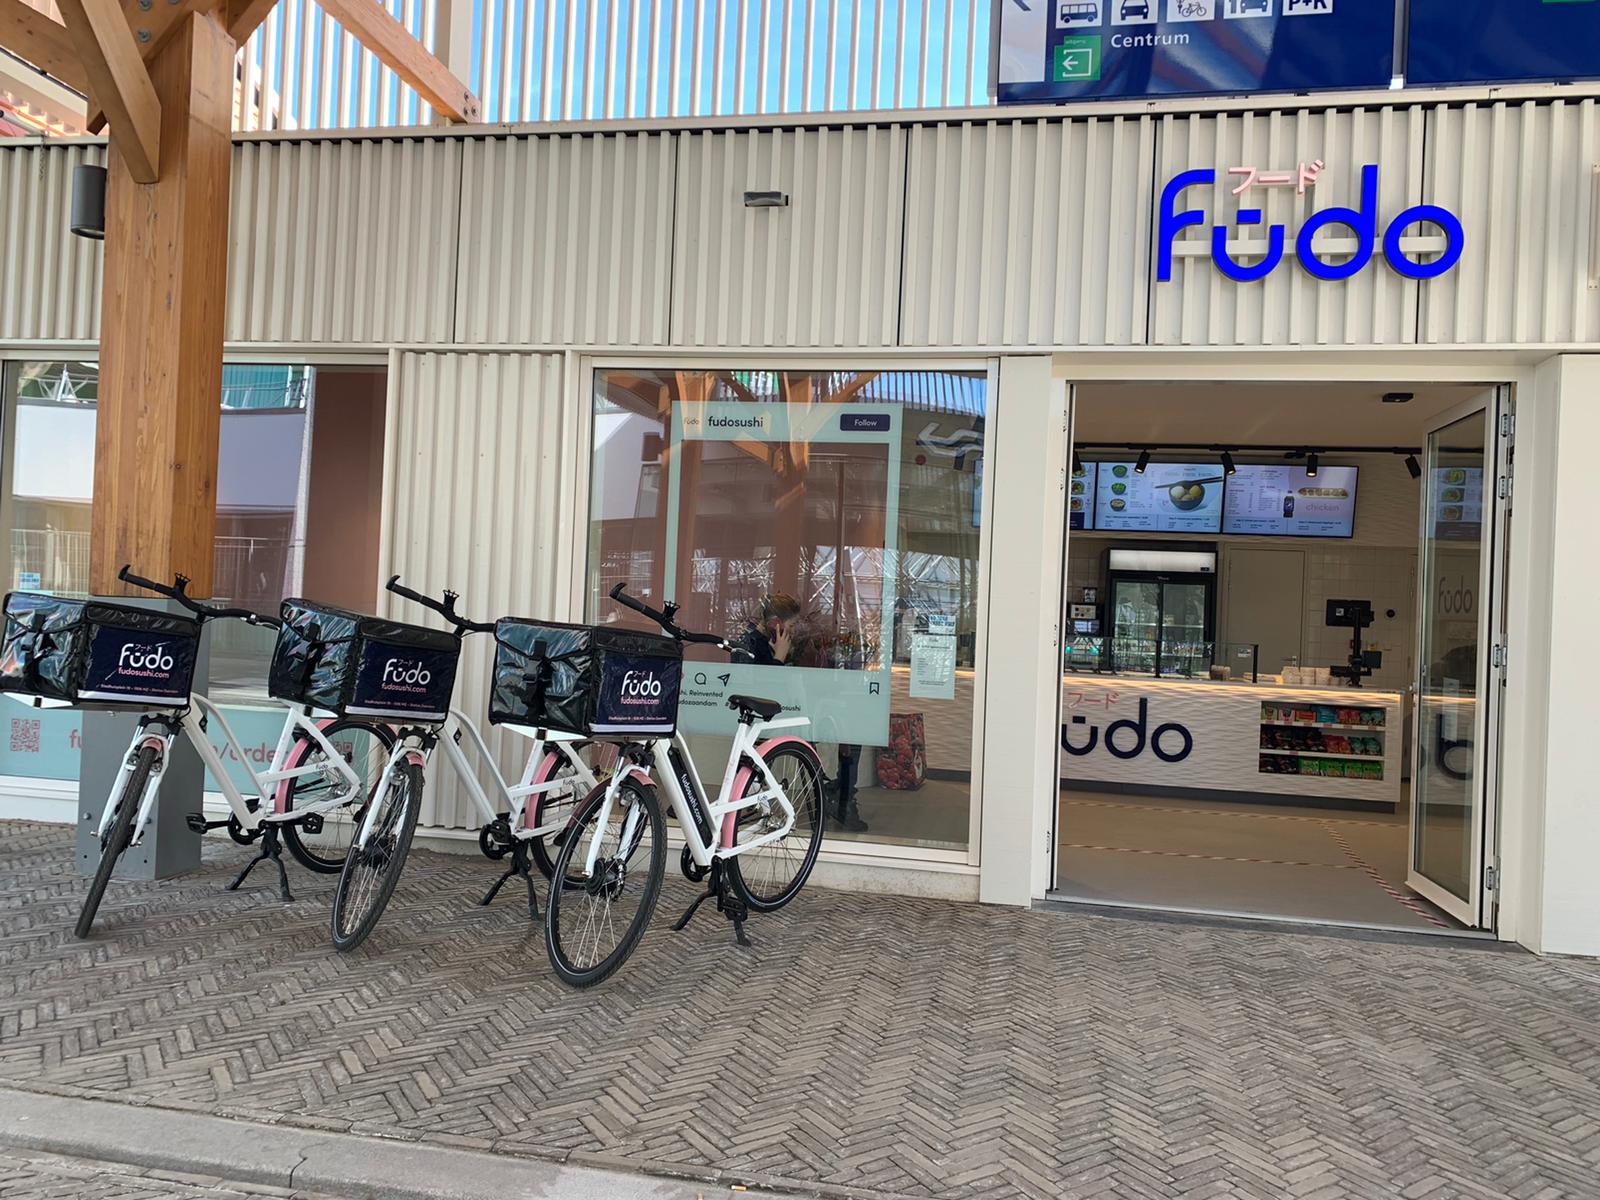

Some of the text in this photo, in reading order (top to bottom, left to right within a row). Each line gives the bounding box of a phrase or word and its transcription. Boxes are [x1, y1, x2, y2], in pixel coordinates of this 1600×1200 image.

[1111, 33, 1190, 48] Centrum
[1228, 159, 1325, 195] フード
[708, 415, 763, 428] fudosushi
[854, 419, 878, 427] Follow
[1305, 503, 1340, 512] chicken
[118, 667, 170, 679] fudosushi.com
[381, 682, 427, 693] fudosushi.com
[689, 689, 724, 698] Reinvented
[620, 696, 660, 705] fudosushi.com
[1067, 692, 1120, 710] フード
[781, 704, 801, 712] osushi
[681, 773, 703, 824] fudosushi.com
